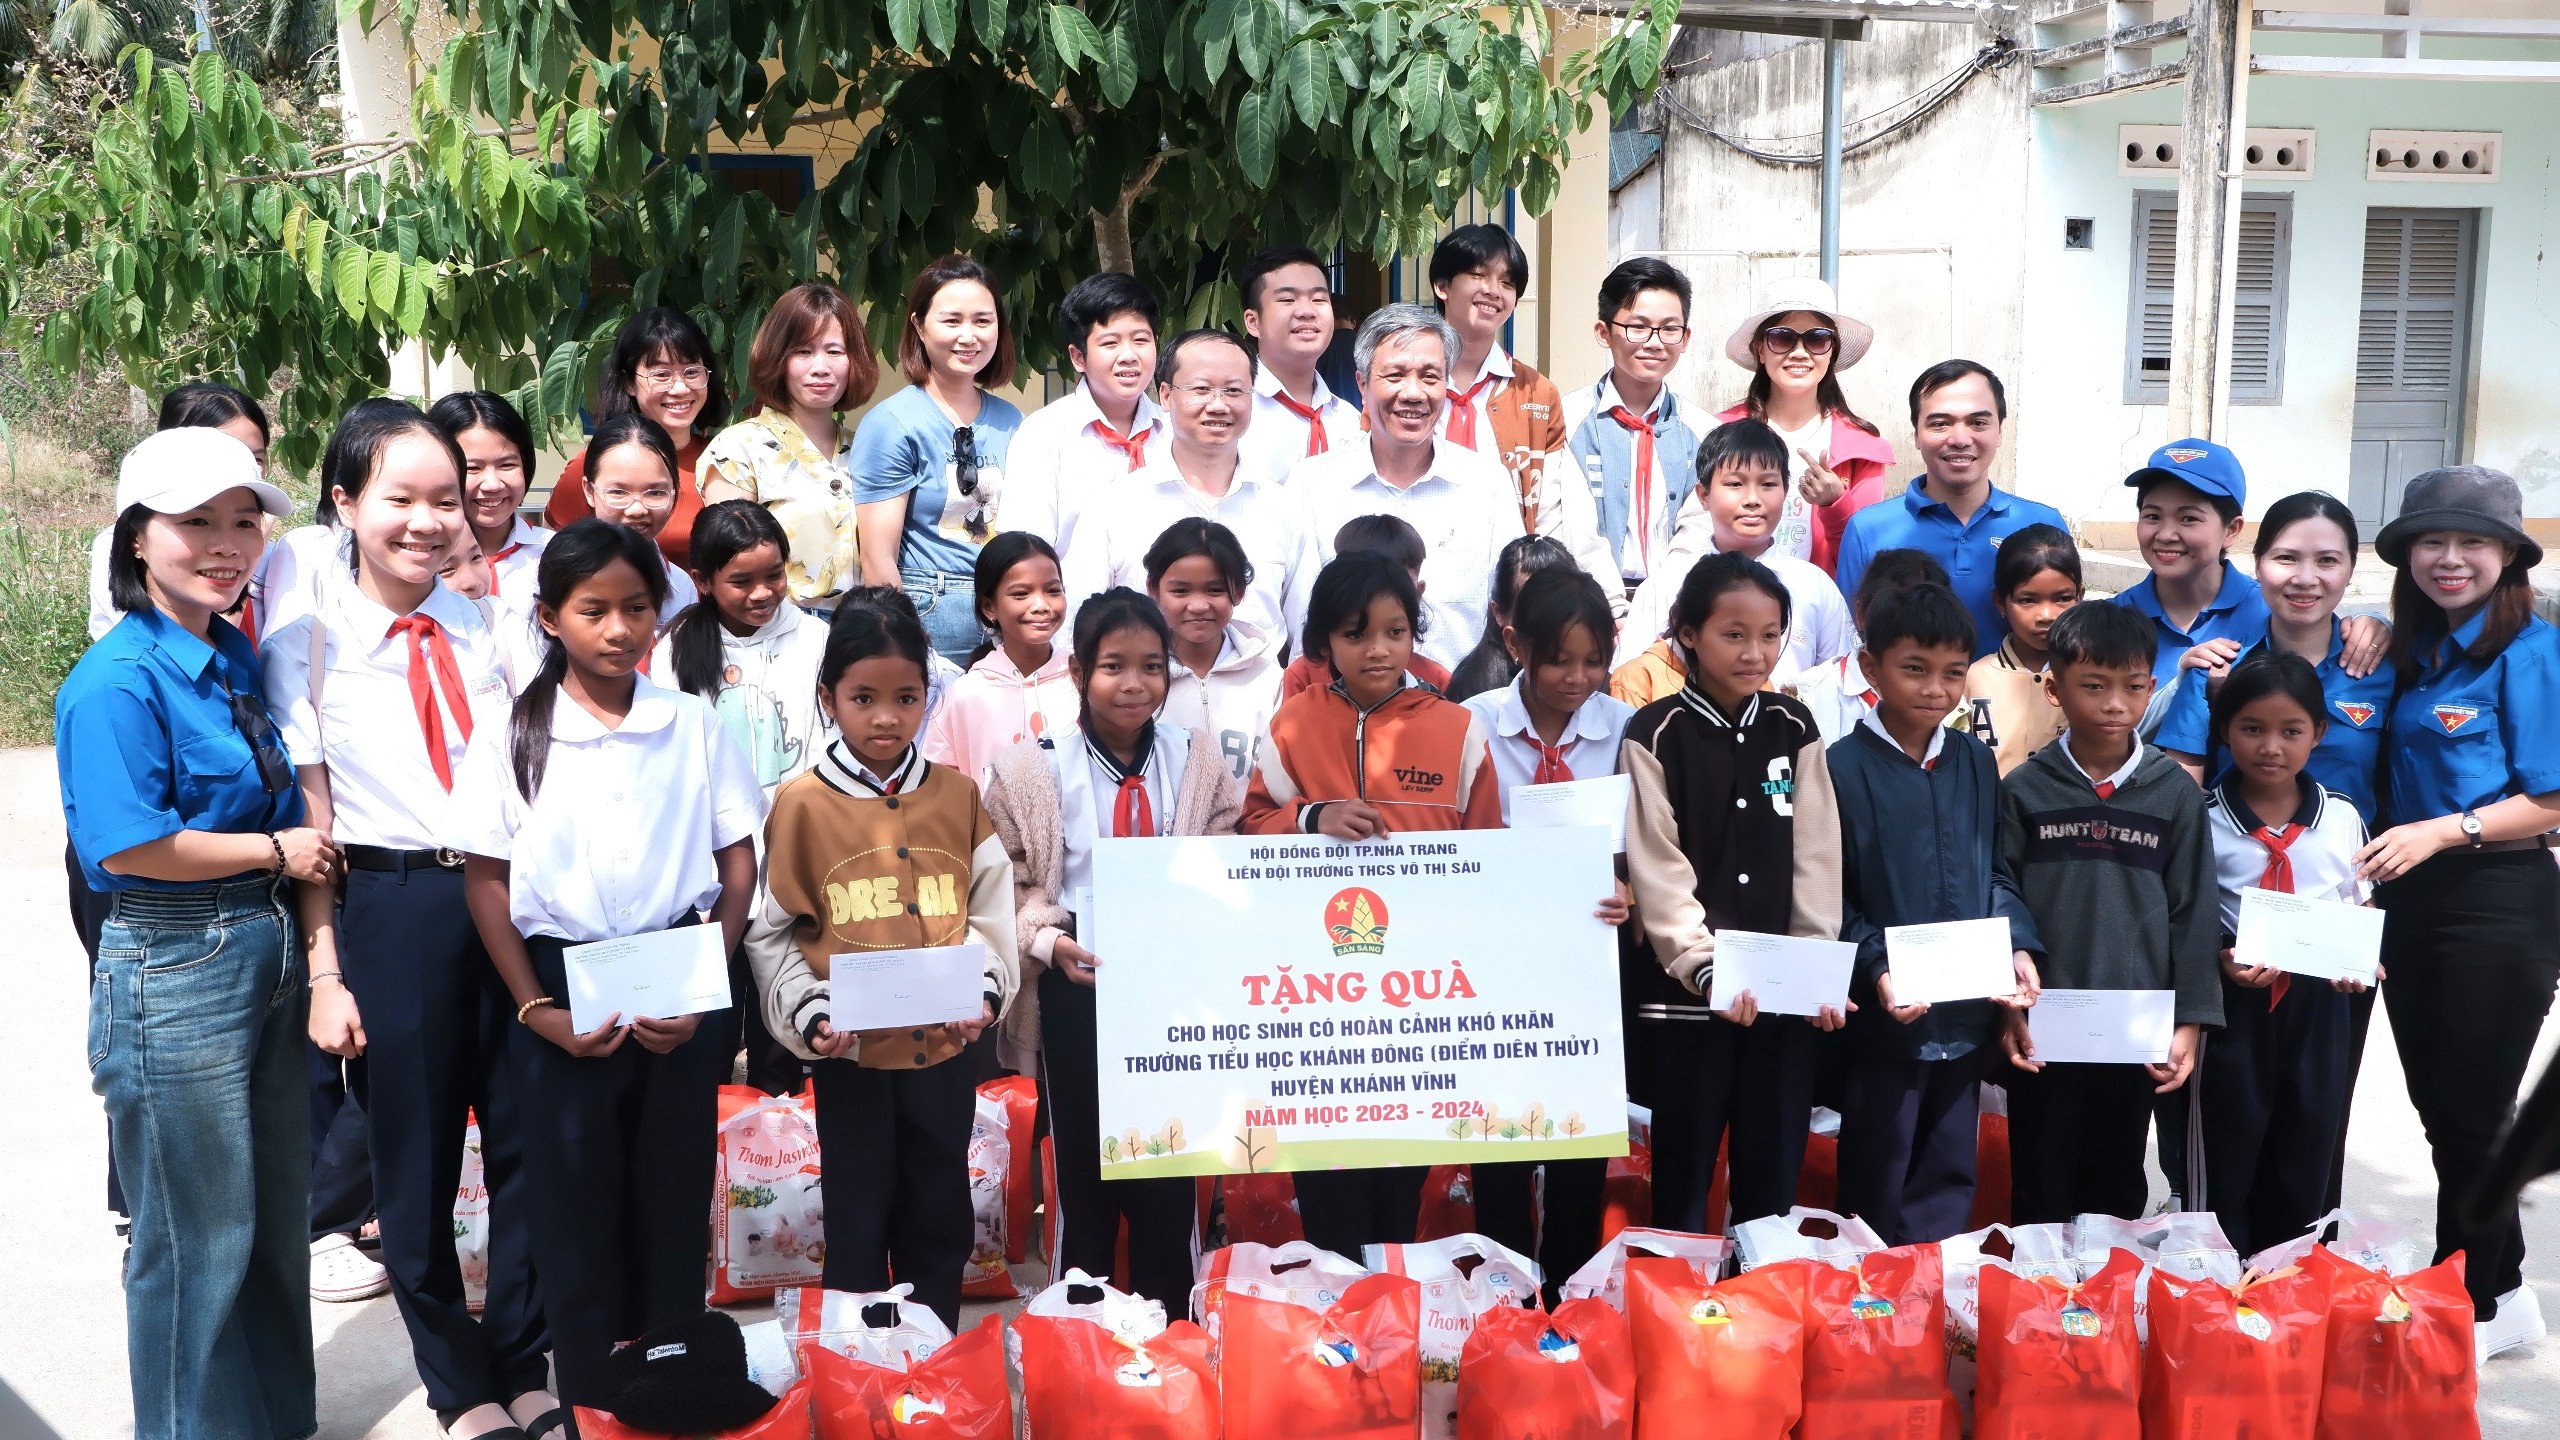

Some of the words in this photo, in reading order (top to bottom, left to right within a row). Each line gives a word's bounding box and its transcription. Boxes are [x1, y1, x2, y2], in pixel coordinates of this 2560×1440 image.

[1394, 765, 1443, 786] vine
[1761, 780, 1794, 794] TAN
[2040, 823, 2090, 840] HUNT
[2109, 825, 2159, 849] TEAM
[1251, 846, 1274, 861] HỘI
[1325, 843, 1350, 860] ĐỘI
[1354, 844, 1404, 858] TP.NHA
[1409, 844, 1457, 855] TRANG
[1228, 866, 1260, 879] LIÊN
[1265, 865, 1289, 881] ĐỘI
[1295, 865, 1353, 877] TRƯỜNG
[1358, 865, 1395, 876] THCS
[1400, 862, 1418, 875] VÕ
[1424, 863, 1446, 876] THỊ
[1452, 860, 1480, 873] SÁU
[1242, 964, 1368, 1013] TẶNG
[1381, 960, 1477, 1008] QUÀ
[1168, 1026, 1205, 1042] CHO
[1213, 1024, 1250, 1044] HỌC
[1258, 1022, 1302, 1039] SINH
[1310, 1018, 1334, 1037] CÓ
[1341, 1016, 1392, 1036] HOÀN
[1400, 1012, 1451, 1034] CẢNH
[1458, 1012, 1495, 1031] KHÓ
[1502, 1010, 1553, 1030] KHĂN
[1124, 1052, 1201, 1073] TRƯỜNG
[1208, 1046, 1248, 1070] TIỂU
[1256, 1051, 1293, 1071] HỌC
[1300, 1046, 1365, 1066] KHÁNH
[1371, 1044, 1423, 1063] ĐÔNG
[1431, 1038, 1486, 1062] (ĐIỂM
[1494, 1039, 1537, 1059] DIÊN
[1544, 1035, 1598, 1057] THỦY)
[1271, 1076, 1333, 1098] HUYỆN
[1341, 1073, 1405, 1093] KHÁNH
[1412, 1071, 1456, 1090] VĨNH
[1245, 1105, 1297, 1126] NĂM
[1304, 1106, 1348, 1127] HỌC
[1356, 1104, 1408, 1122] 2023
[1432, 1101, 1484, 1119] 2024
